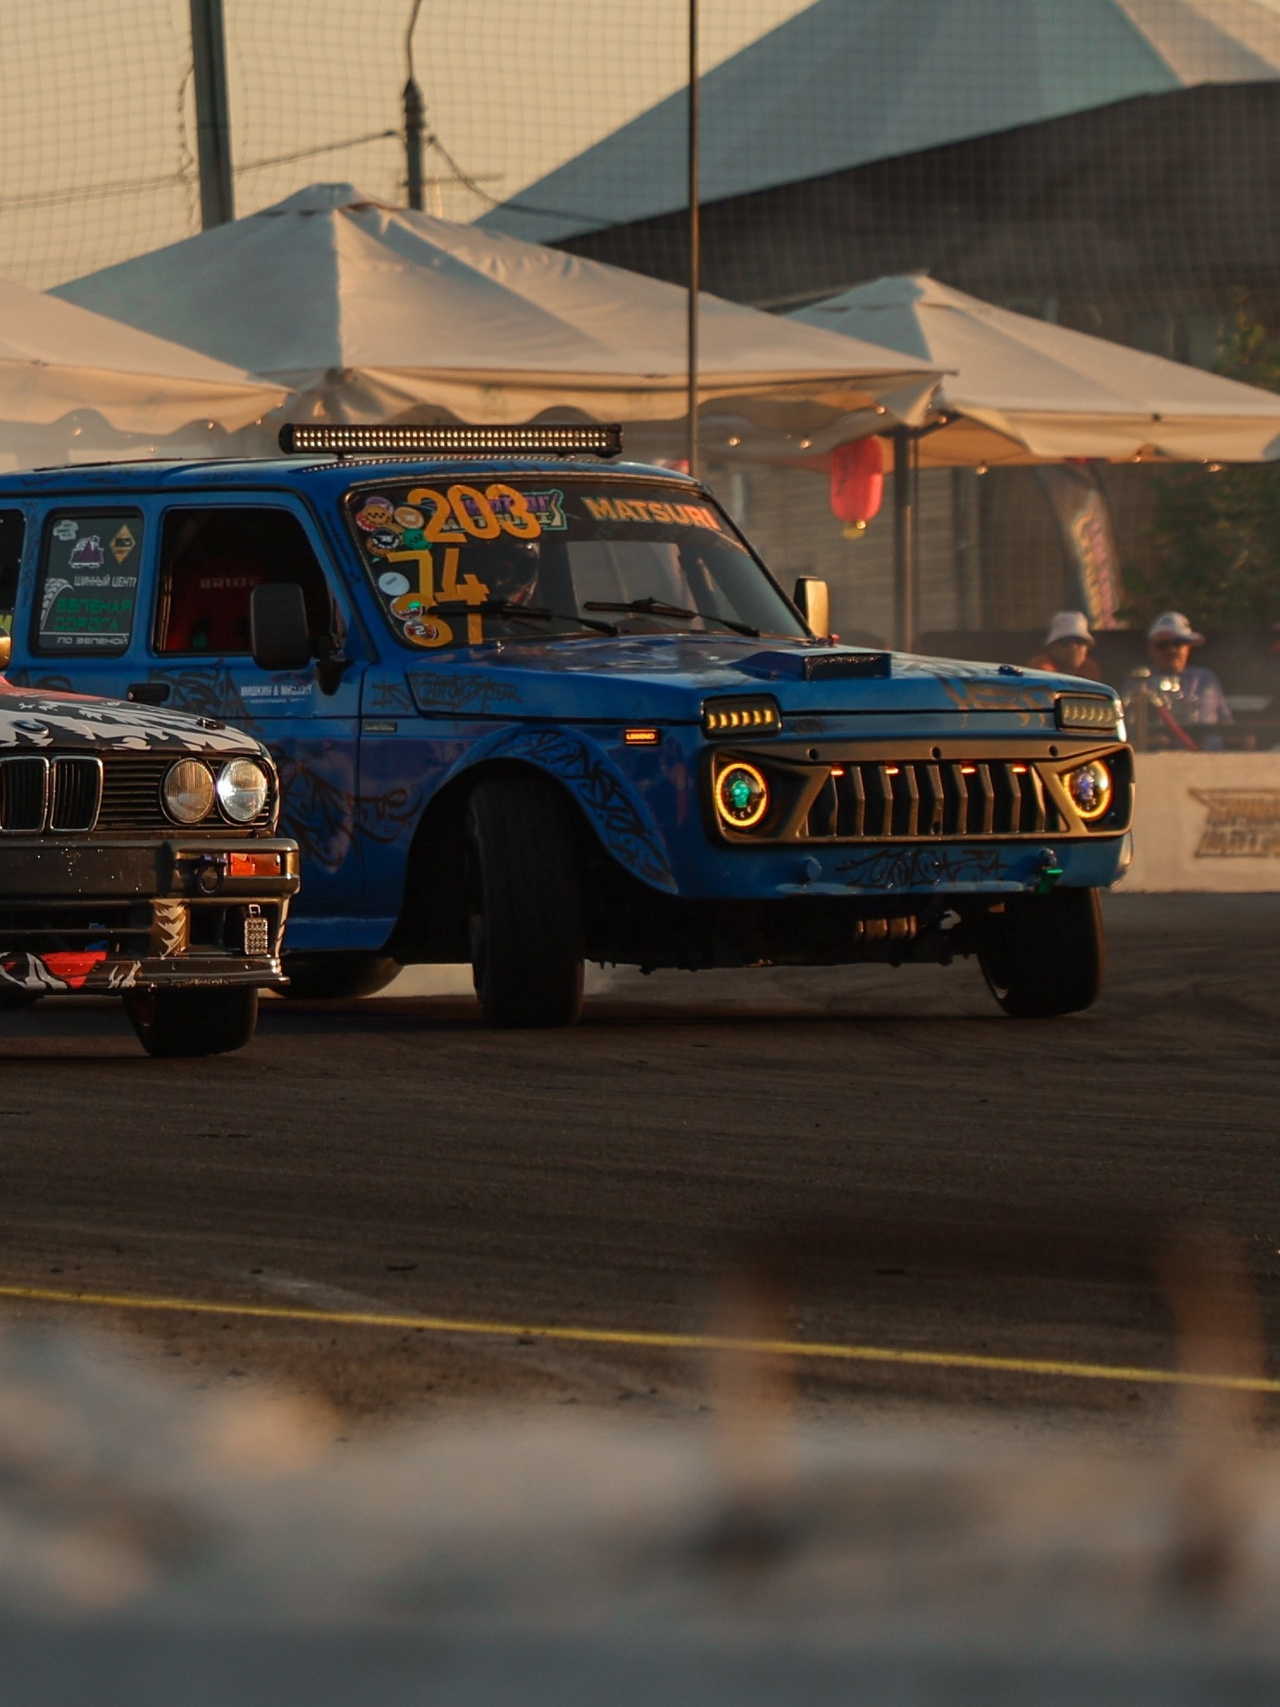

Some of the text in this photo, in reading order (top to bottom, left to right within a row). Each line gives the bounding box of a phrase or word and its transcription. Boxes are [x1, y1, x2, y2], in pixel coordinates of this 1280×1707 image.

[407, 483, 541, 542] 203
[582, 498, 721, 531] MATSURI
[74, 575, 110, 587] ШИННЫЙ
[57, 636, 72, 644] ПО
[625, 732, 656, 741] LEGEND
